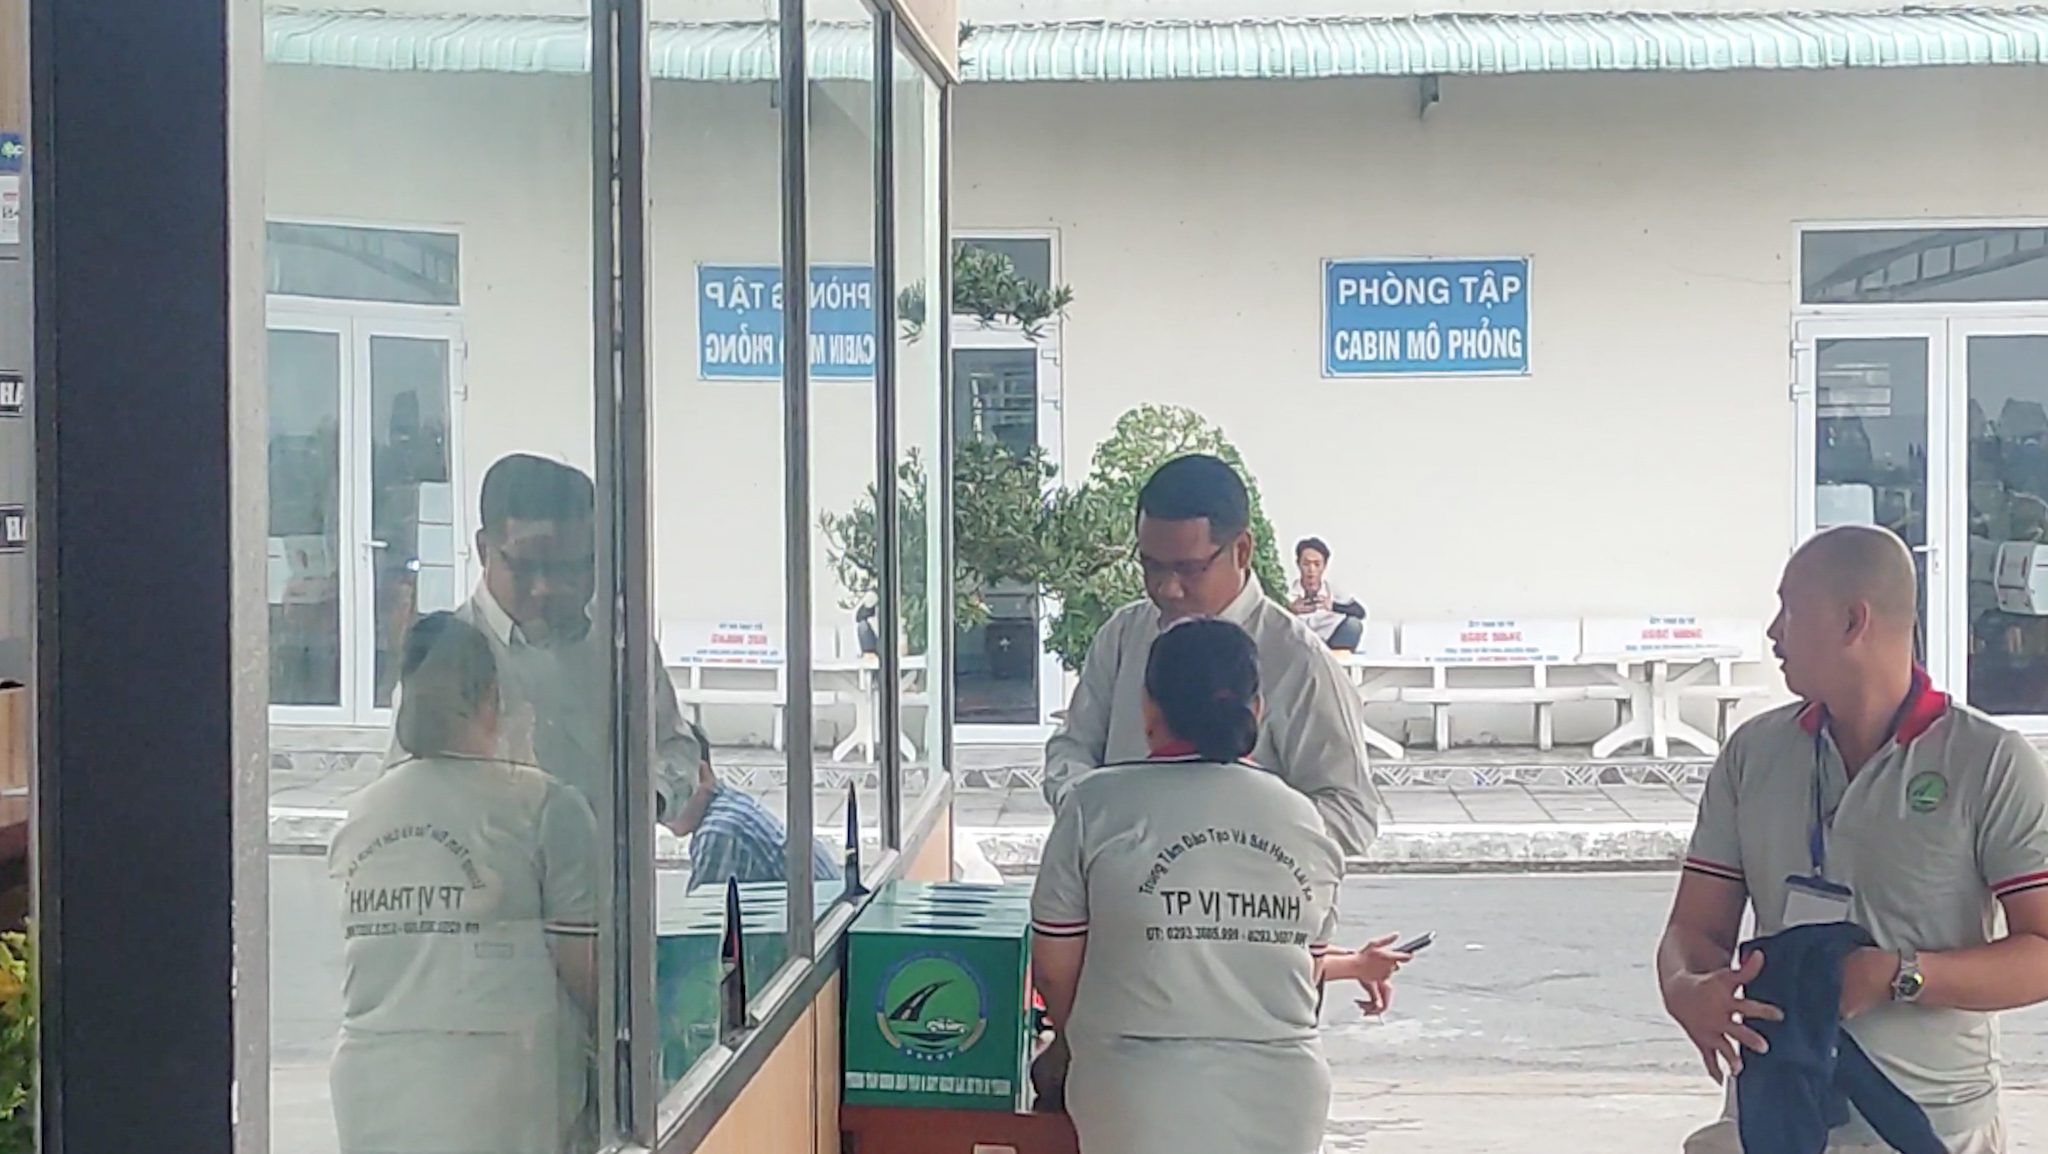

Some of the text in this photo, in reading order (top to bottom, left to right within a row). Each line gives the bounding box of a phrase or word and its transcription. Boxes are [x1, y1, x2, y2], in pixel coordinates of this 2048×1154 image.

[1338, 269, 1521, 309] PHÒNG TẬP
[1335, 317, 1522, 360] CABIN MÔ PHỎNG
[1160, 889, 1300, 923] TP VỊ THANH
